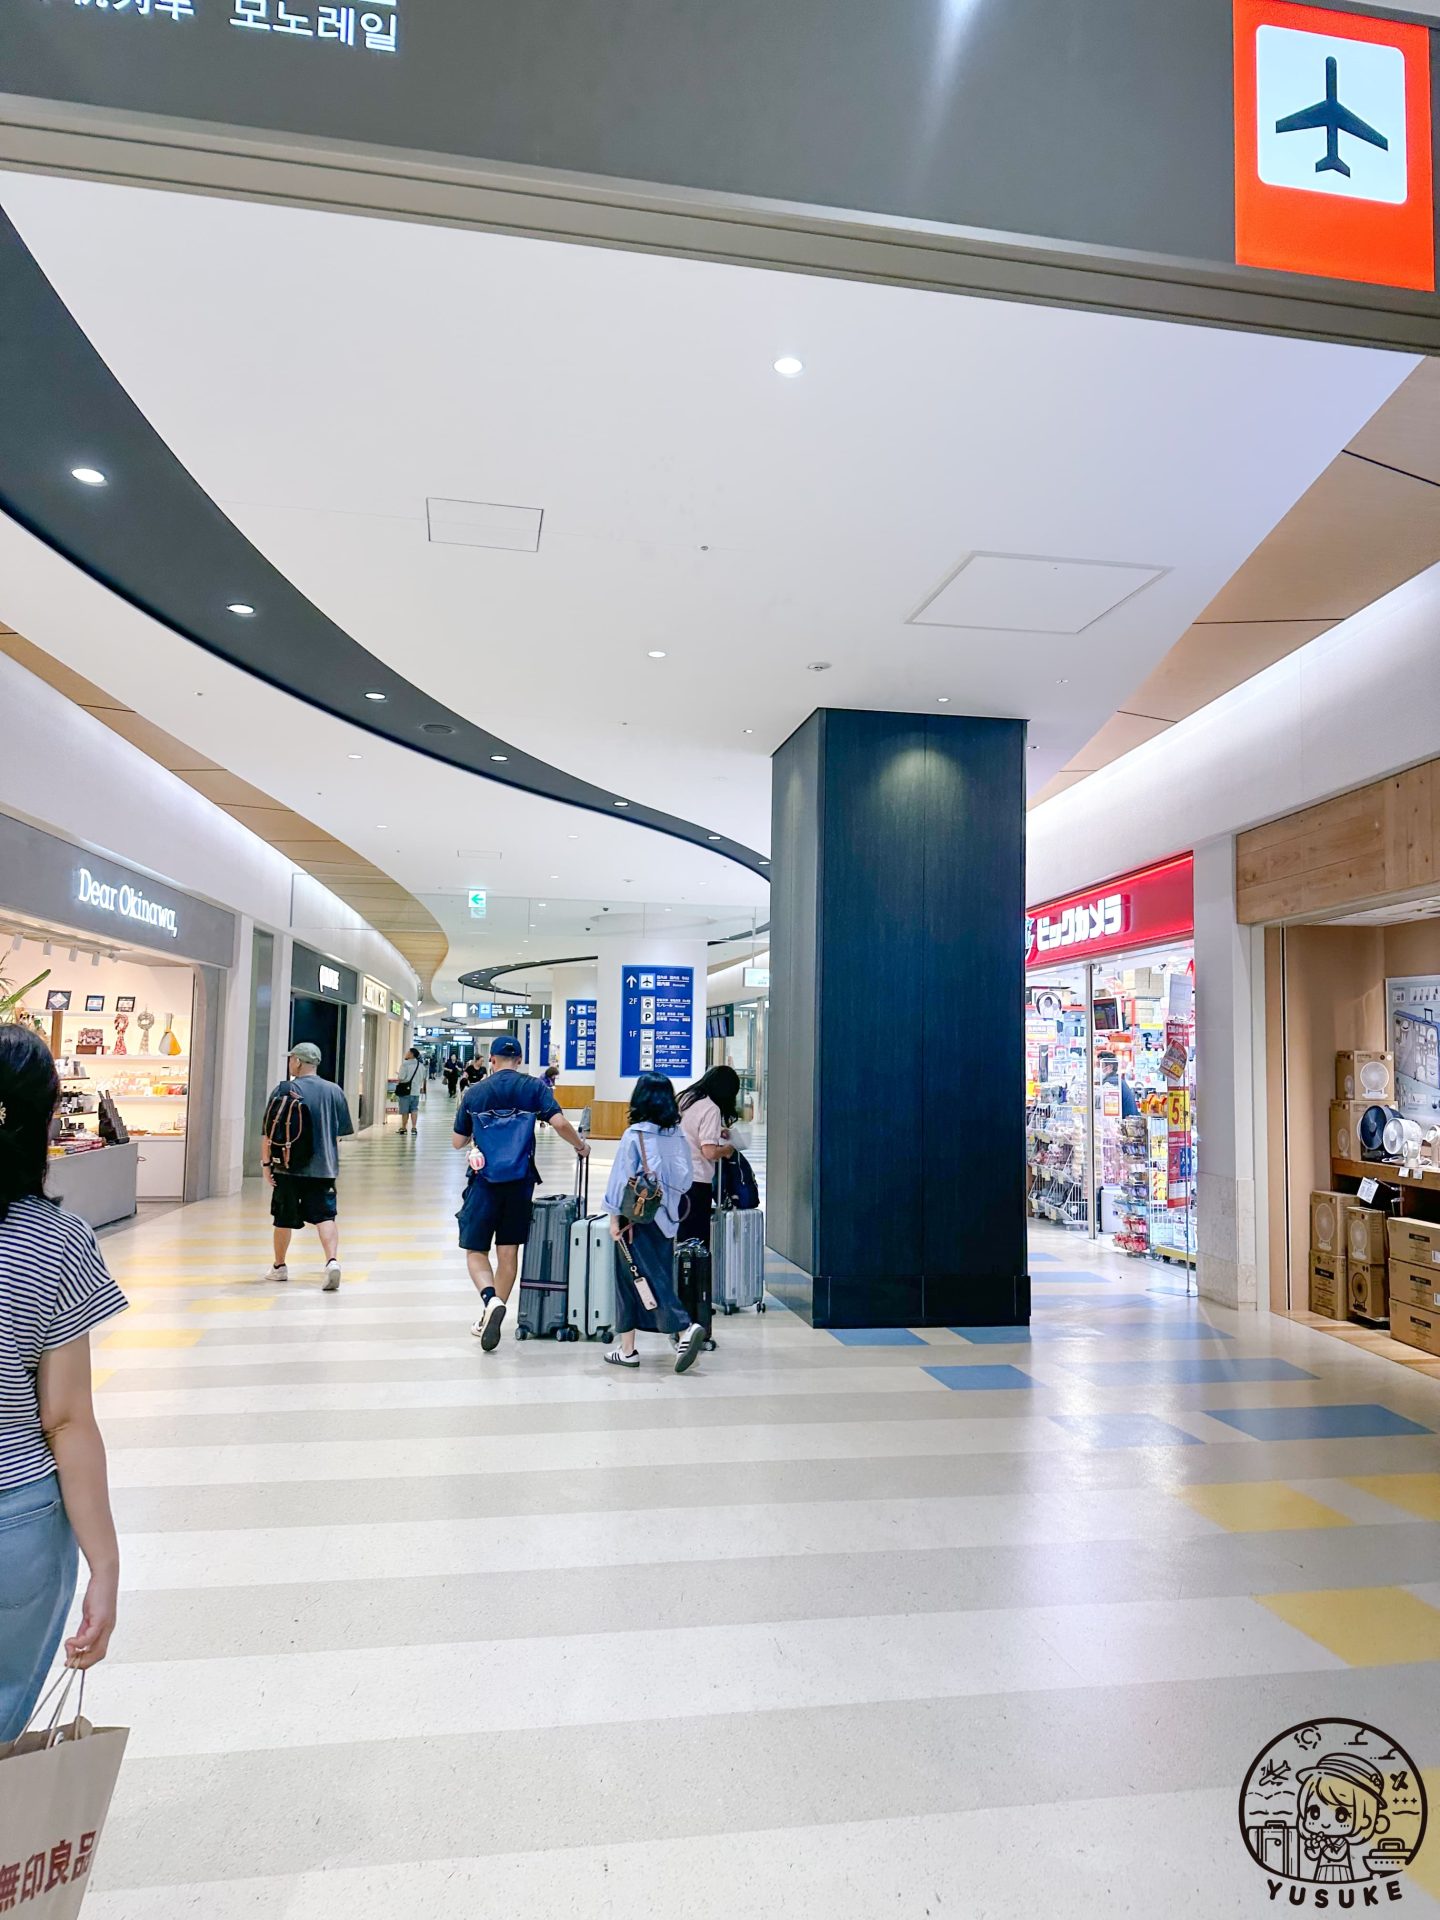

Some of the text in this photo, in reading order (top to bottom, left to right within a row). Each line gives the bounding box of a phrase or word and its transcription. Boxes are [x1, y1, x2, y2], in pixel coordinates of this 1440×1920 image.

[229, 0, 398, 52] 모노레일
[78, 867, 118, 911] Dear
[1036, 893, 1122, 952] ビックカメラ
[628, 997, 638, 1005] 2F
[645, 1013, 652, 1021] P
[0, 1829, 97, 1913] 無印良品
